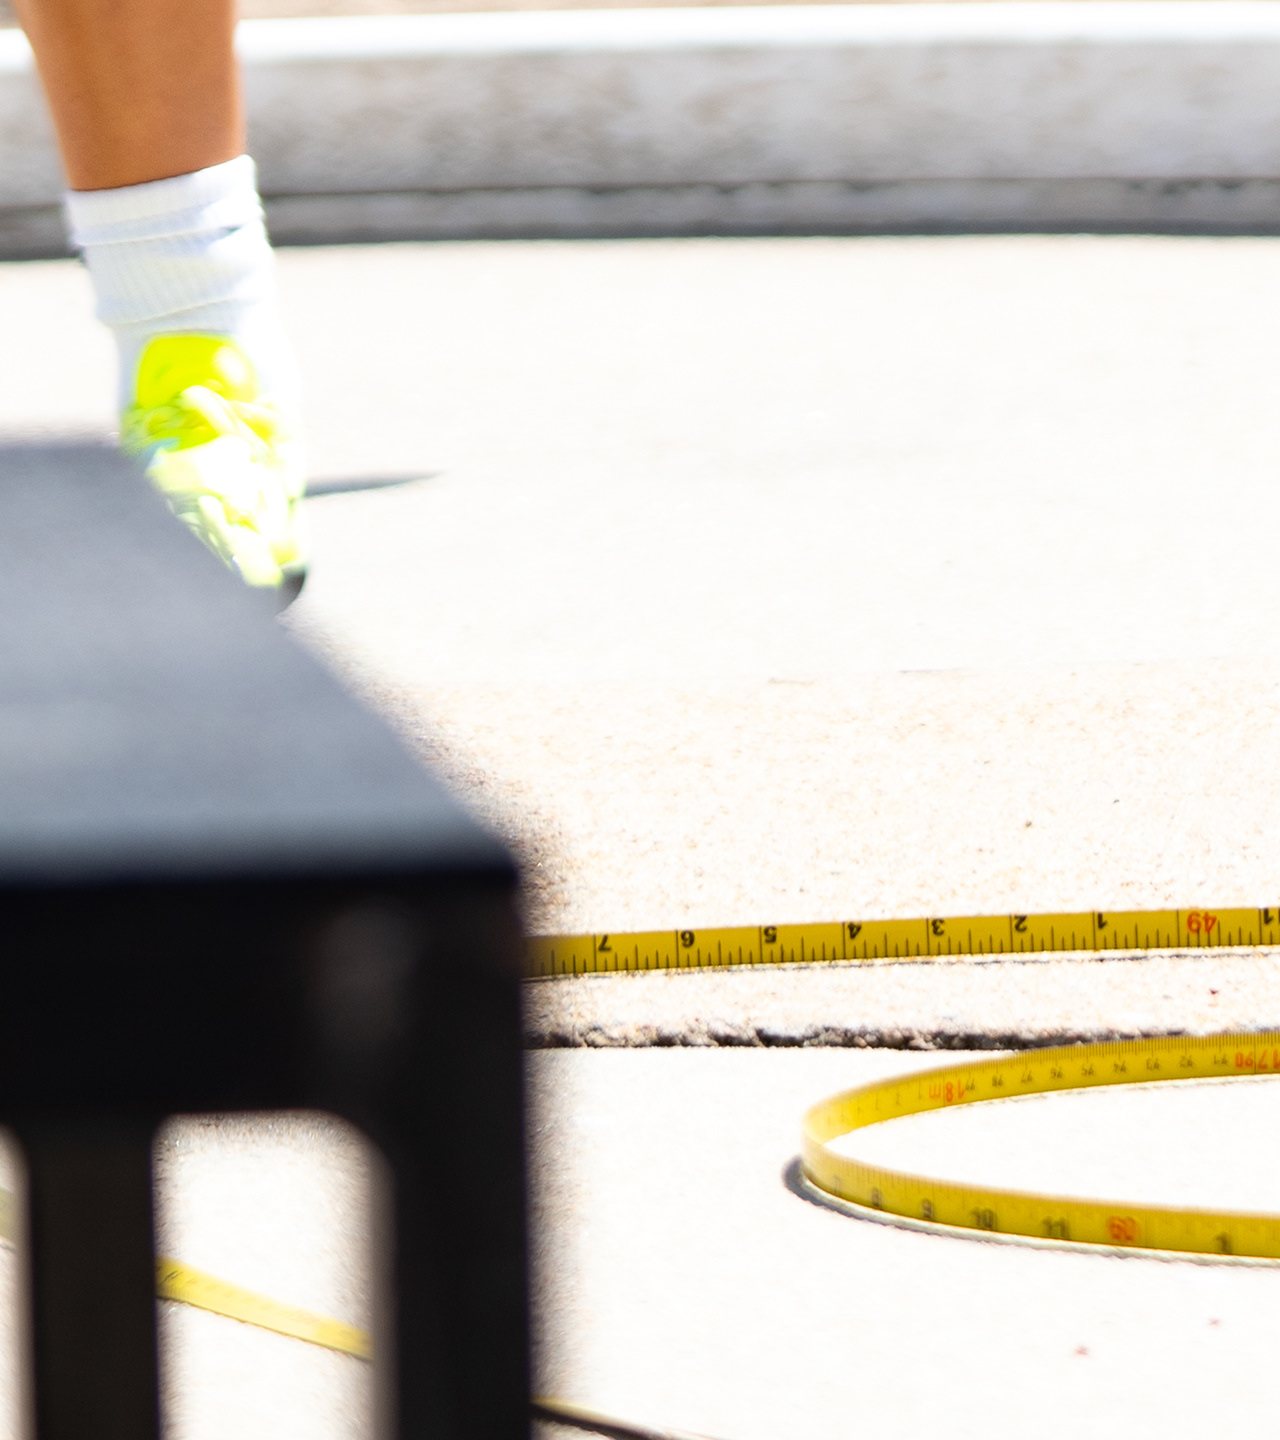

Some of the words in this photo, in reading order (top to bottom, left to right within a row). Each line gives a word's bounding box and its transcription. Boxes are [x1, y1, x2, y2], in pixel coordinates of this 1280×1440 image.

[846, 921, 862, 939] 4
[931, 918, 946, 936] 3
[1014, 915, 1028, 933] 2
[1095, 912, 1108, 930] 1
[1186, 911, 1218, 935] 49
[597, 934, 613, 953] 7
[680, 929, 696, 948] 6
[763, 925, 778, 944] 5
